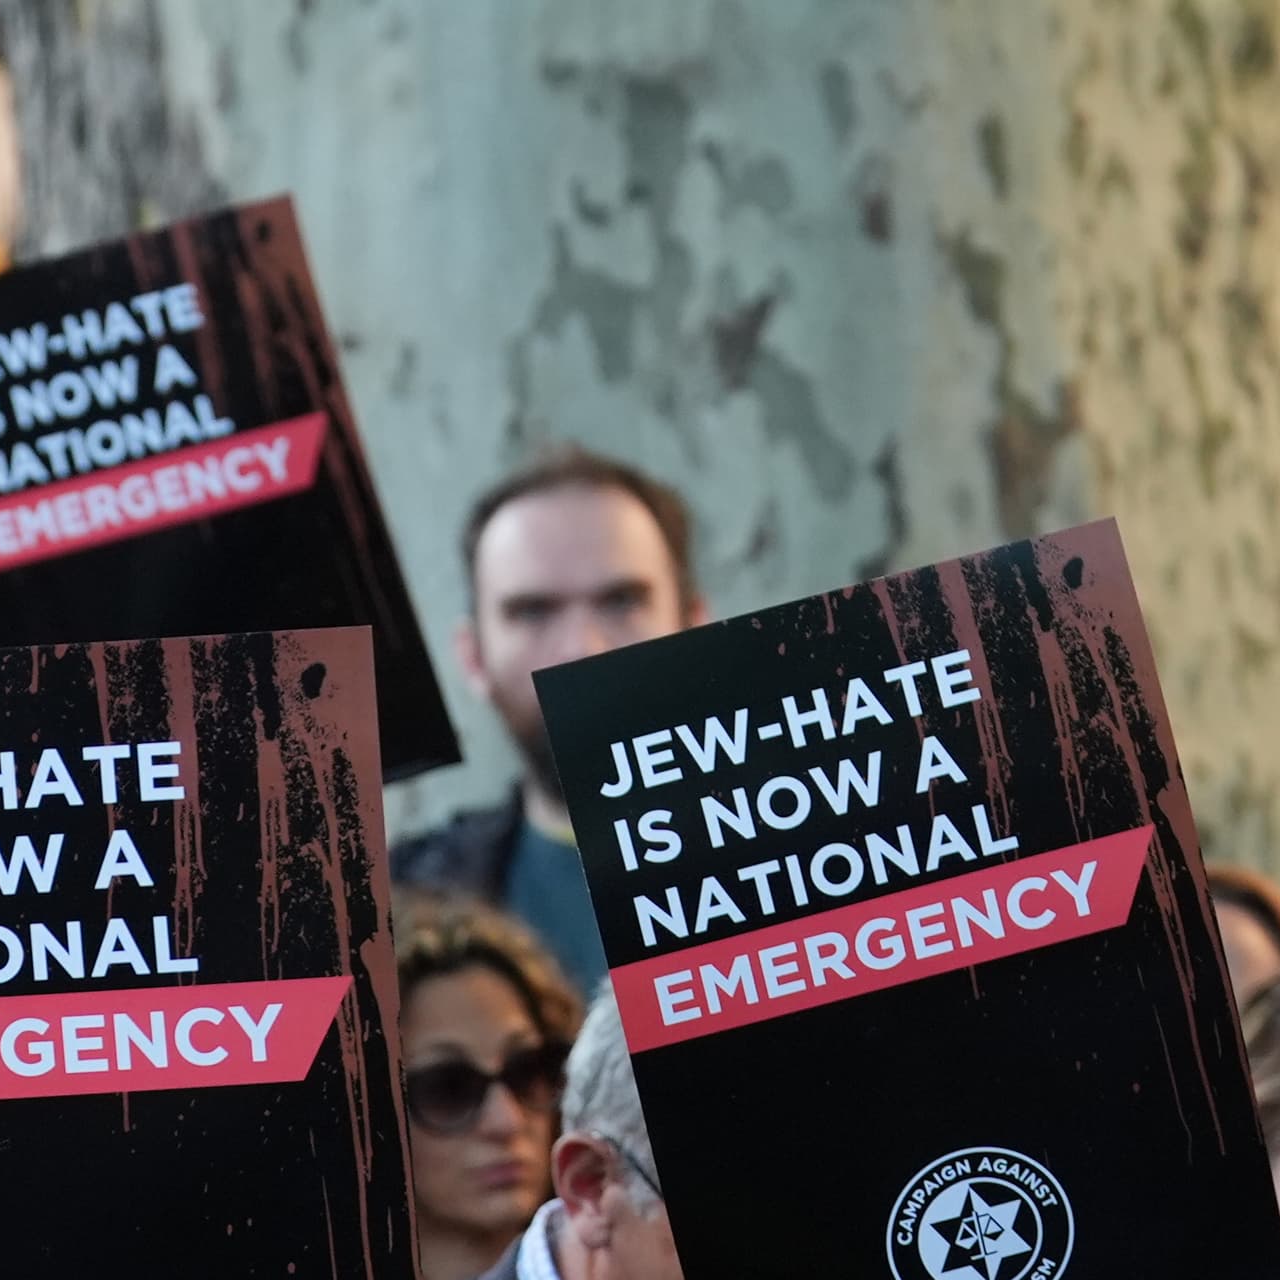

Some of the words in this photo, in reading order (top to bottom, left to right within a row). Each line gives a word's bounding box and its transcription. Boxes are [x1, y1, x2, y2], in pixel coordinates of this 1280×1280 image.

[12, 356, 138, 421] NOW
[156, 346, 195, 393] A
[600, 649, 982, 798] JEW-HATE
[95, 830, 154, 891] A
[614, 809, 684, 872] IS
[700, 751, 882, 848] NOW
[916, 736, 968, 794] A
[633, 804, 1019, 948] NATIONAL
[653, 860, 1098, 1026] EMERGENCY
[896, 1158, 972, 1246] CAMPAIGN
[977, 1157, 1058, 1208] AGAINST
